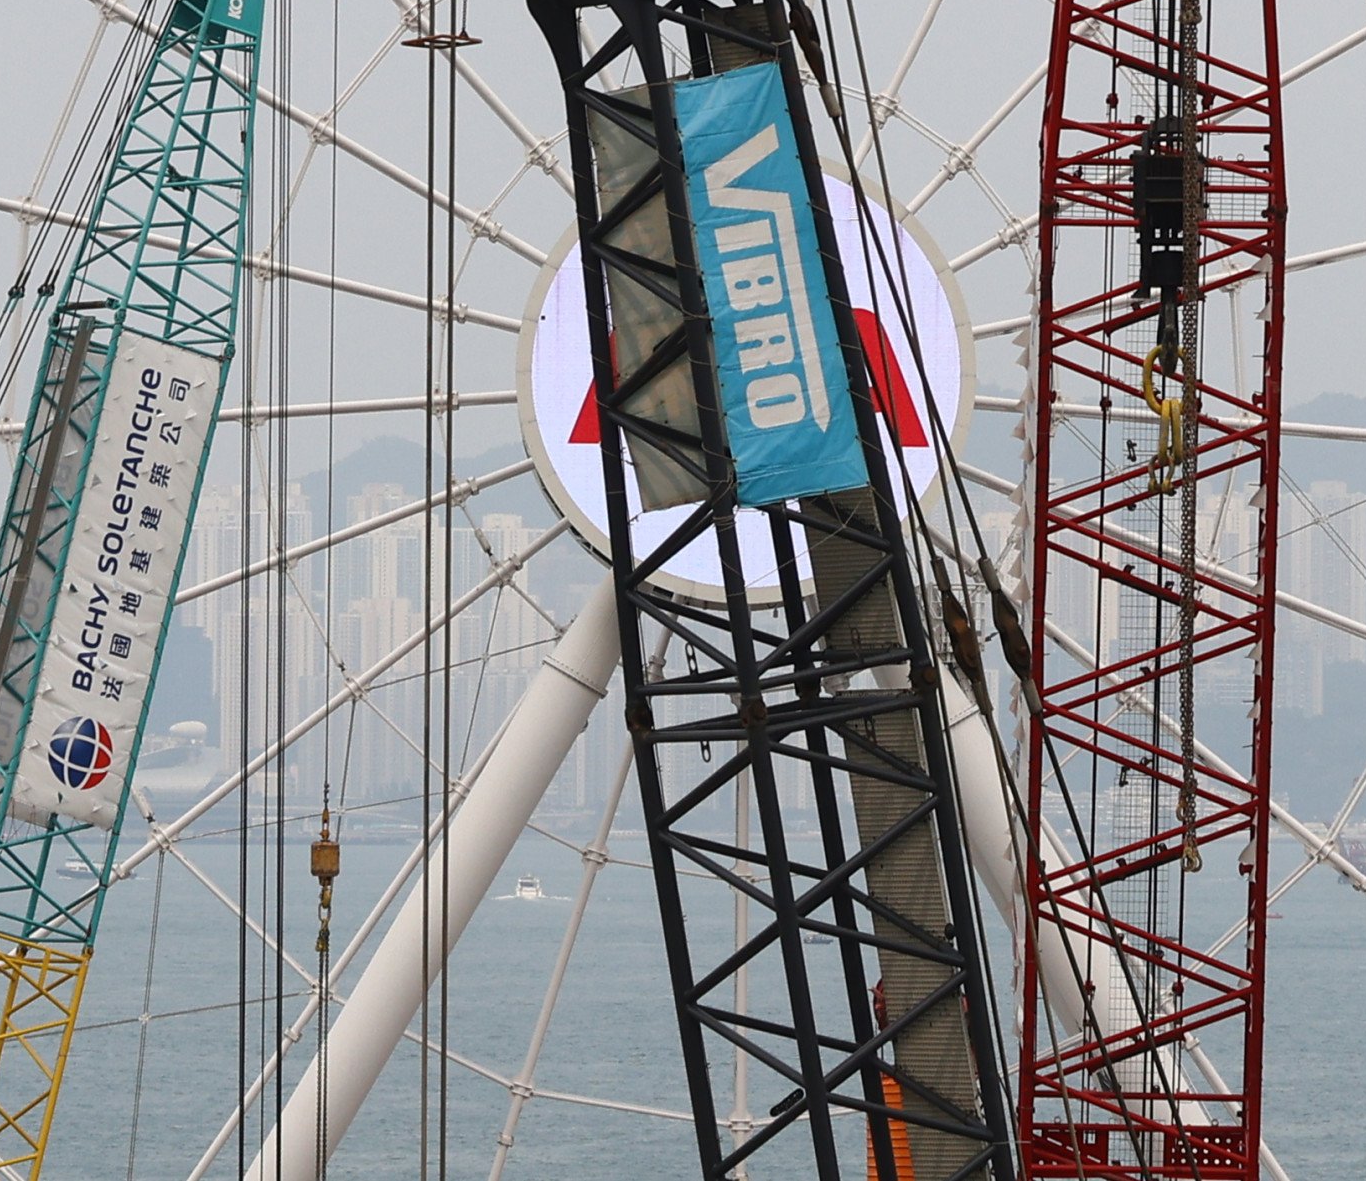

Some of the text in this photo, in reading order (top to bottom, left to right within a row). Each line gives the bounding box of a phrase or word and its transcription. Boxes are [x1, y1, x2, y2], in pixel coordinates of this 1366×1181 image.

[703, 123, 831, 433] VIBRO
[72, 583, 111, 693] BACHY
[100, 377, 192, 702] 法國地基建築公司
